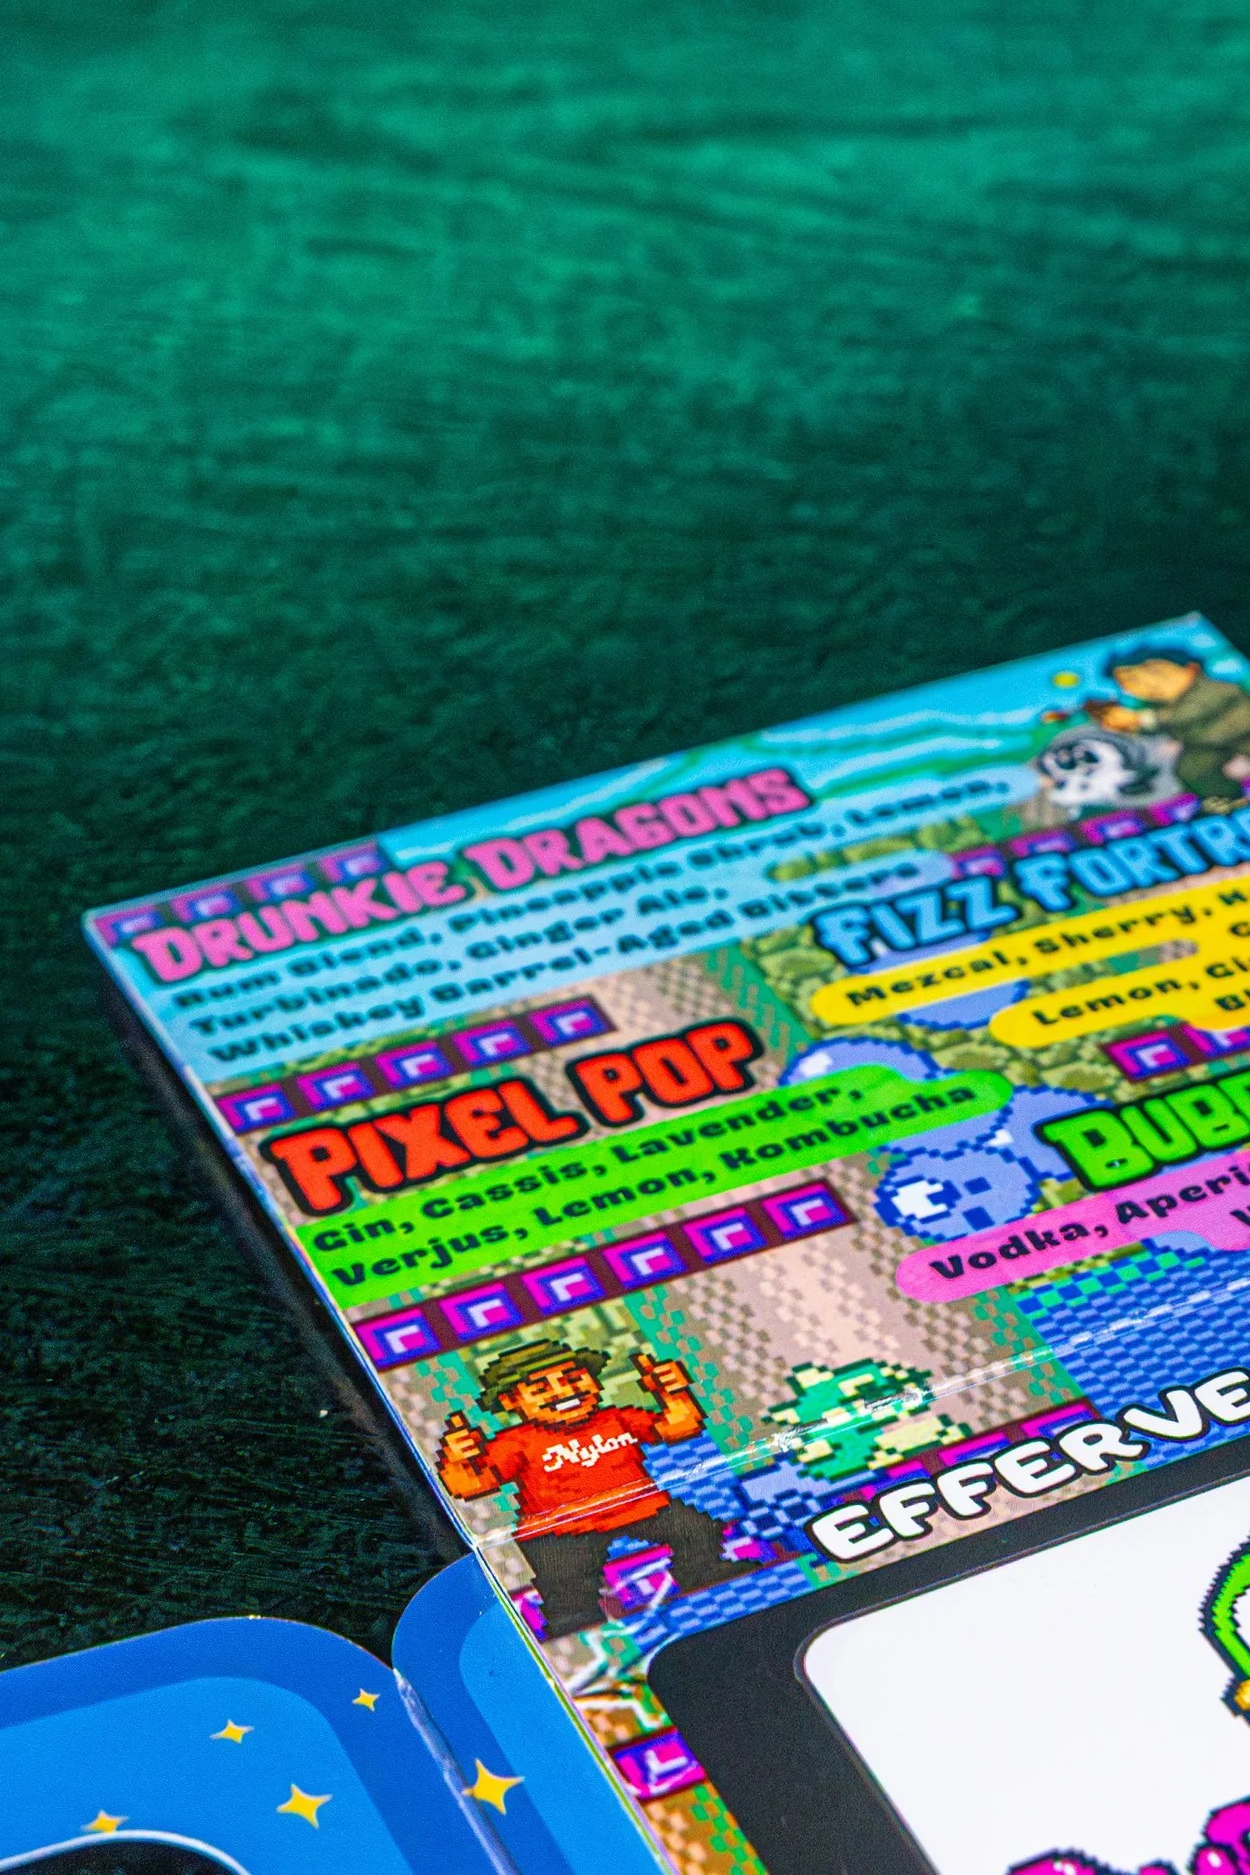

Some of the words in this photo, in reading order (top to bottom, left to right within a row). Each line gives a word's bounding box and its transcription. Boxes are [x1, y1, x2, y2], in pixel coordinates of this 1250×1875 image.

[133, 860, 467, 983] DRUNKIE
[464, 767, 810, 891] DRAGONS
[172, 971, 282, 1009] Rum
[286, 927, 443, 976] Blend,
[448, 862, 683, 934] Pineapple
[847, 779, 1010, 825] Lemon,
[813, 874, 1019, 967] FIZZ
[188, 957, 462, 1036] Turbinado,
[465, 907, 624, 962] Ginger
[207, 994, 426, 1062] Whiskey
[429, 909, 735, 1004] Barrel-Aged
[737, 862, 921, 920] Bitters
[845, 950, 1028, 1007] Mezcal,
[1032, 903, 1213, 956] Sherry,
[1032, 977, 1200, 1026] Lemon,
[268, 1079, 581, 1212] PIXEL
[574, 1021, 755, 1123] POP
[313, 1216, 415, 1252] Gin,
[421, 1158, 607, 1219] Cassis,
[612, 1085, 864, 1163] Lavender,
[331, 1224, 529, 1287] Verjus,
[532, 1160, 716, 1227] Lemon,
[719, 1086, 977, 1171] Kombucha
[929, 1220, 1109, 1280] Vodka,
[541, 1432, 638, 1472] Nylon
